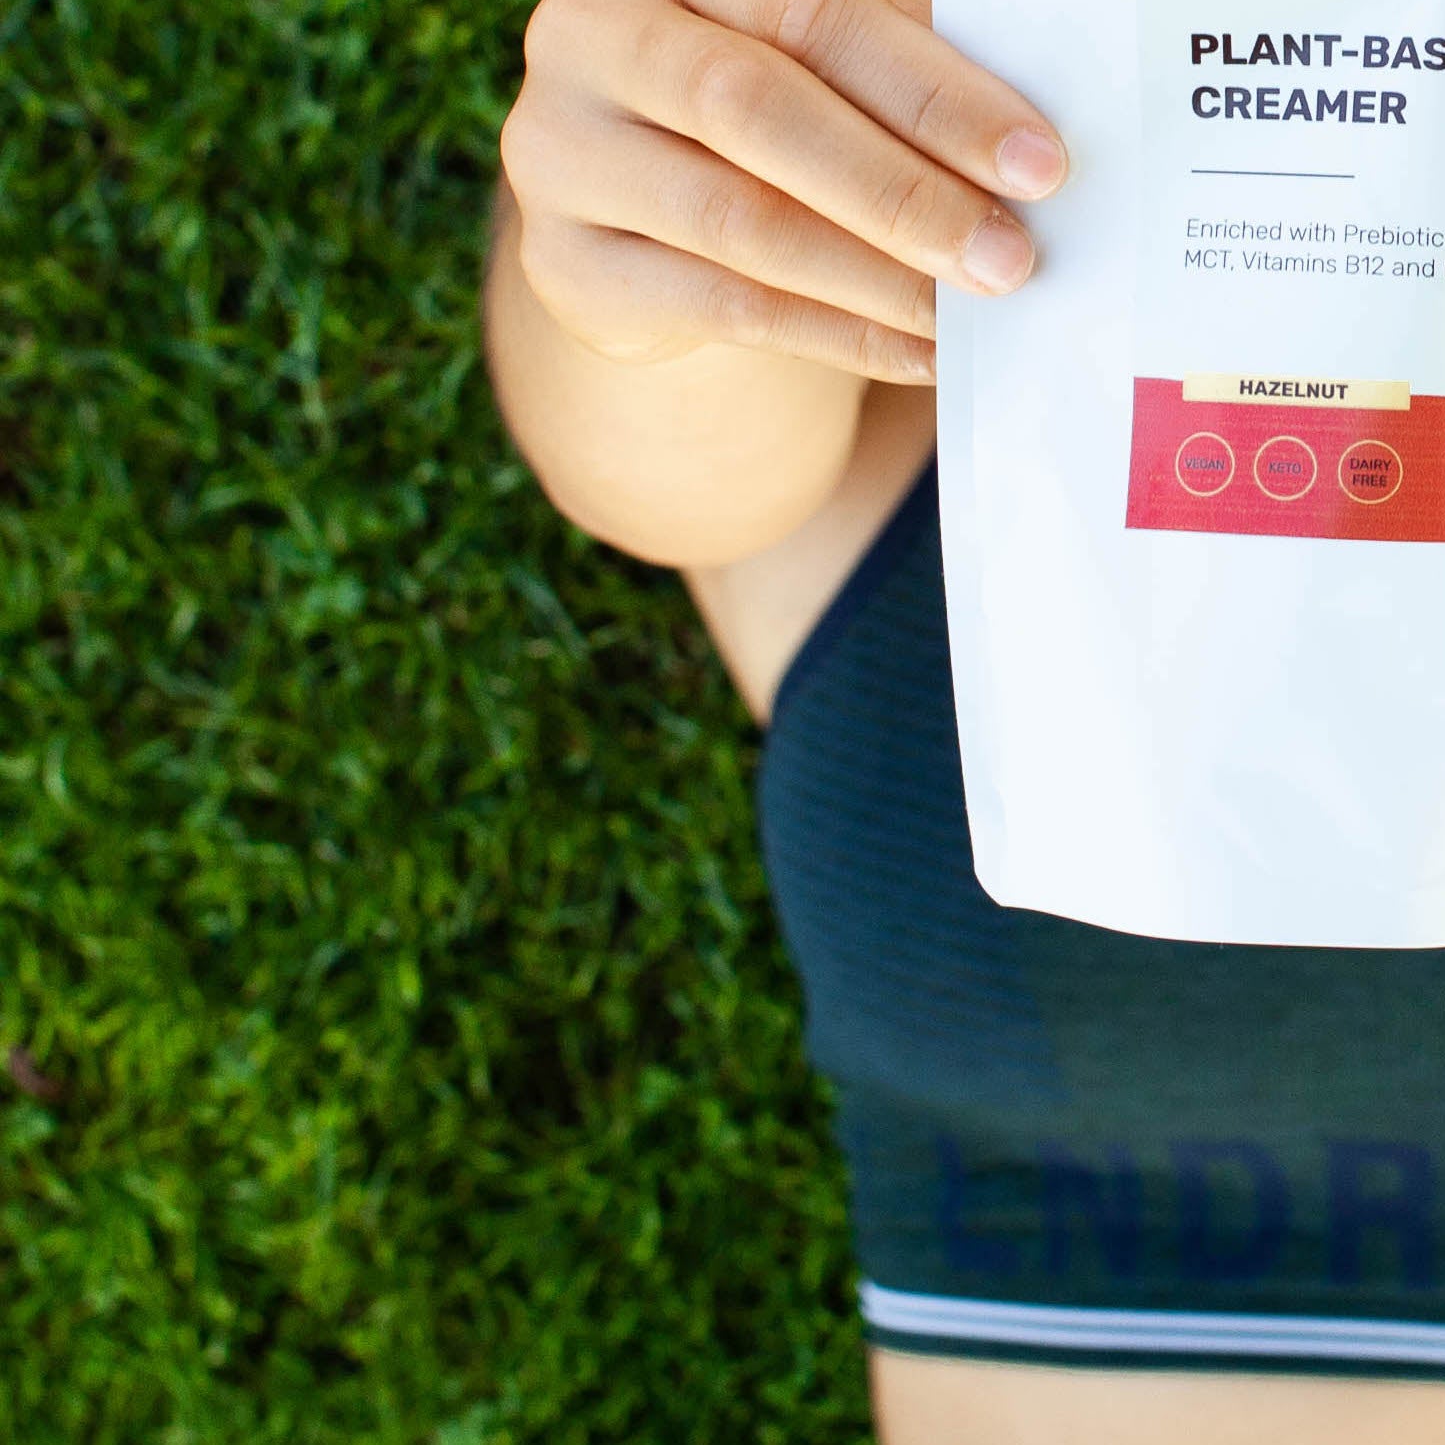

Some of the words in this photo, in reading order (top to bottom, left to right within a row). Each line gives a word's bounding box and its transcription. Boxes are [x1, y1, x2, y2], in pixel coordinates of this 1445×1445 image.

[1191, 85, 1408, 125] CREAMER
[1186, 218, 1282, 241] Enriched
[1289, 222, 1336, 243] with
[1184, 249, 1235, 272] MCT,
[1242, 250, 1337, 274] Vitamins
[1345, 255, 1385, 276] B12
[1391, 258, 1435, 278] and
[1239, 379, 1349, 400] HAZELNUT
[1184, 457, 1225, 471] VEGAN
[1268, 461, 1301, 475] KETO
[1349, 457, 1393, 472] DAIRY
[1352, 473, 1388, 488] FREE
